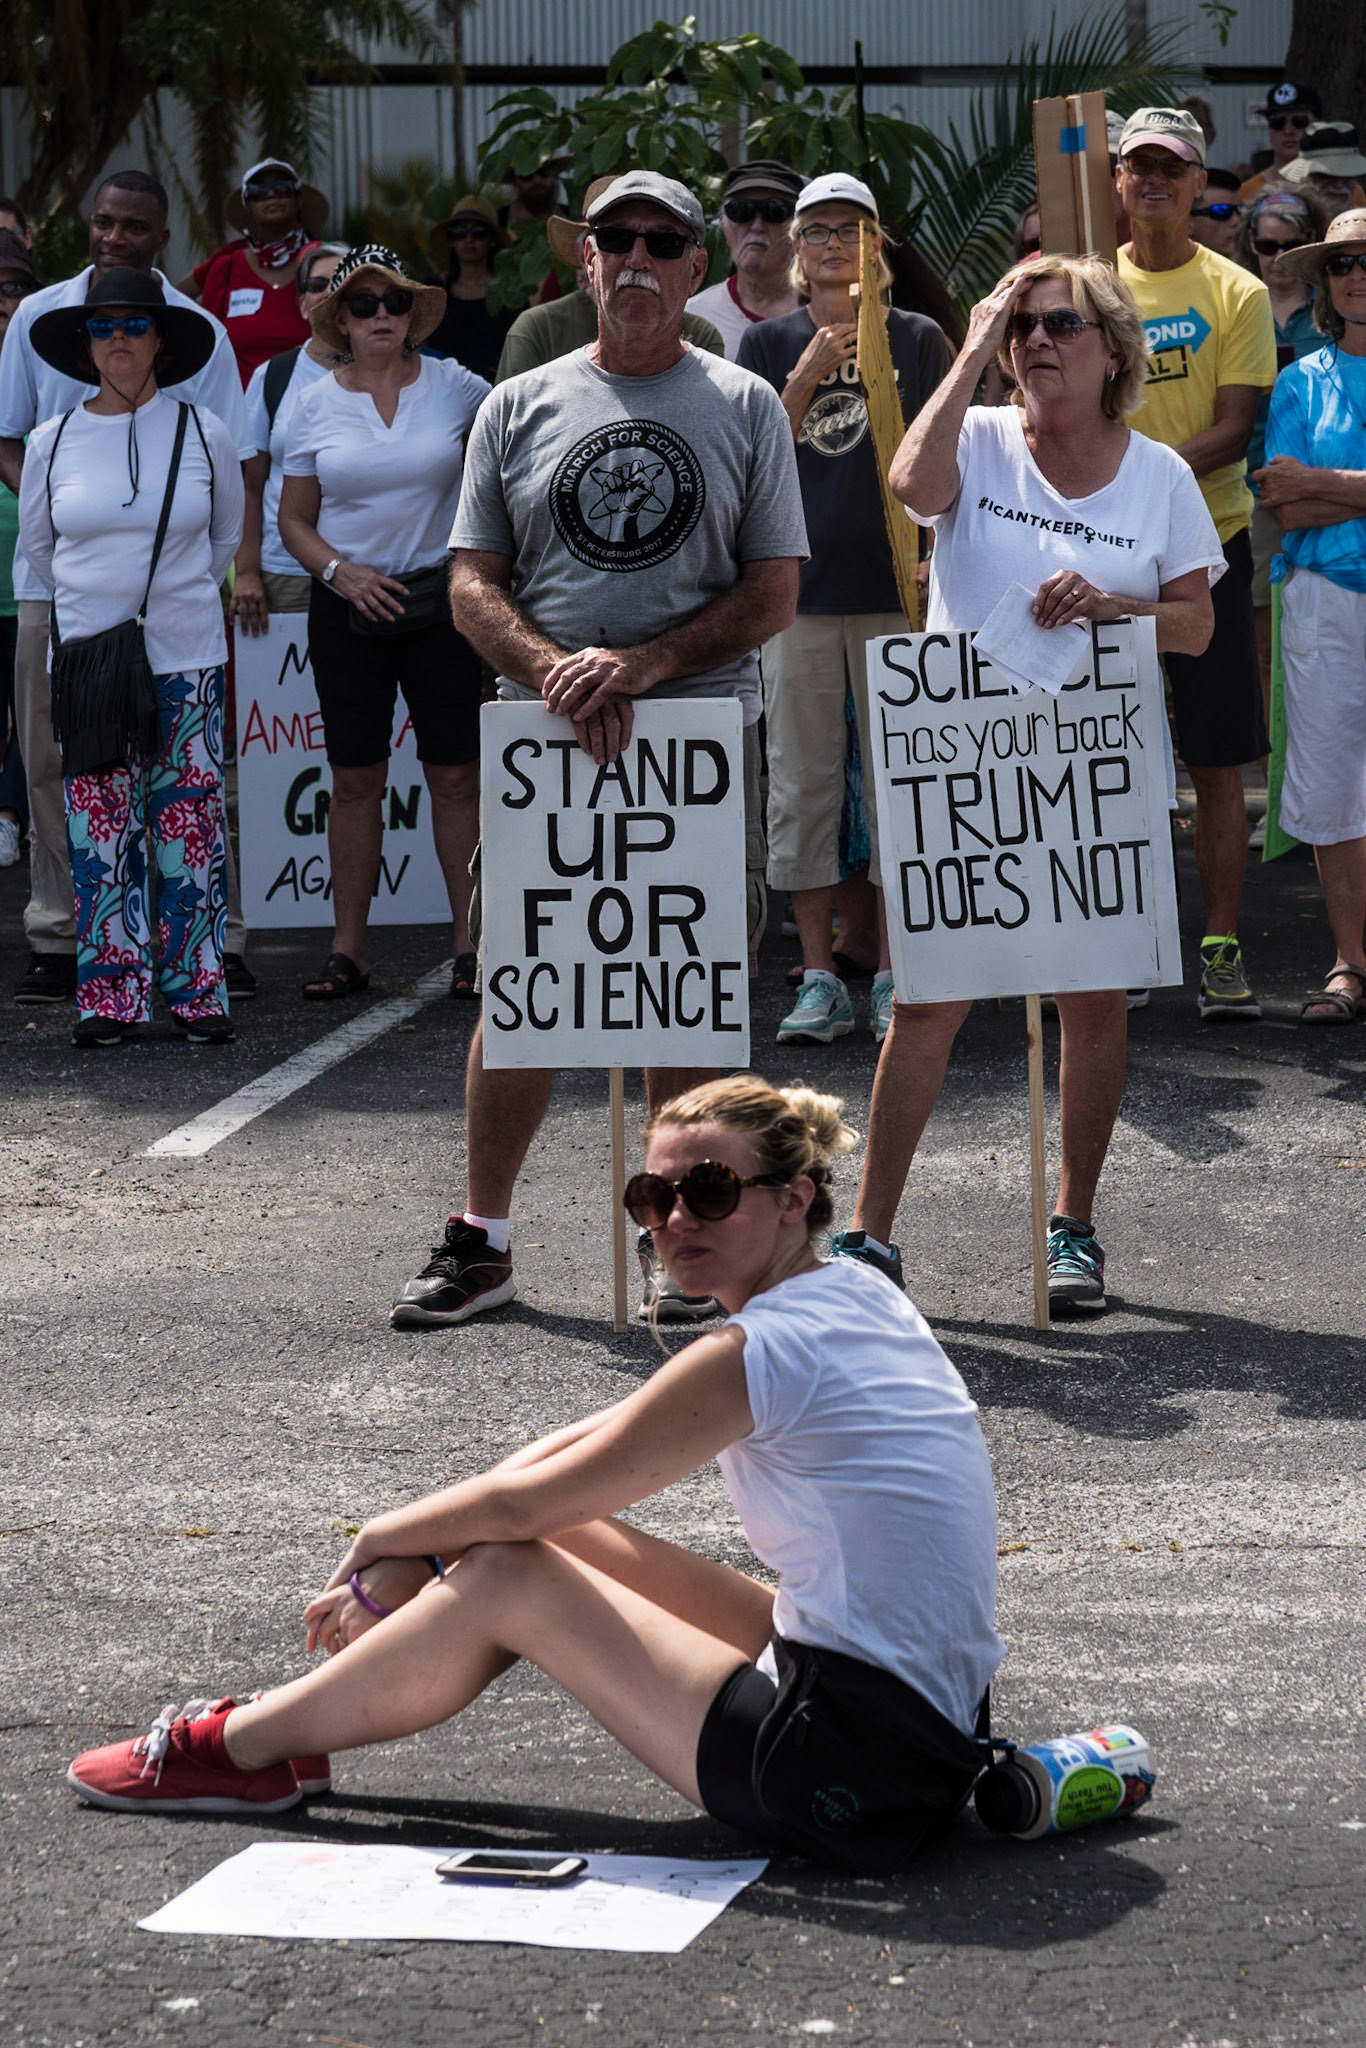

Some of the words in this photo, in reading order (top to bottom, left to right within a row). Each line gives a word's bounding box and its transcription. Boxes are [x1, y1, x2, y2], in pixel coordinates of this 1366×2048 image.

[1144, 321, 1197, 346] OND
[561, 441, 605, 493] MARCH
[607, 430, 643, 447] FOR
[646, 433, 693, 493] SCIENCE
[644, 538, 663, 553] 2017
[878, 617, 1136, 707] SCIEE
[880, 706, 958, 769] has
[964, 711, 1049, 772] your
[1053, 694, 1144, 755] back
[501, 738, 730, 809] STAND
[891, 755, 1132, 854] TRUMP
[547, 812, 676, 881] UP
[523, 885, 706, 957] FOR
[899, 851, 1030, 933] DOES
[1049, 839, 1150, 923] NOT
[489, 960, 742, 1032] SCIENCE
